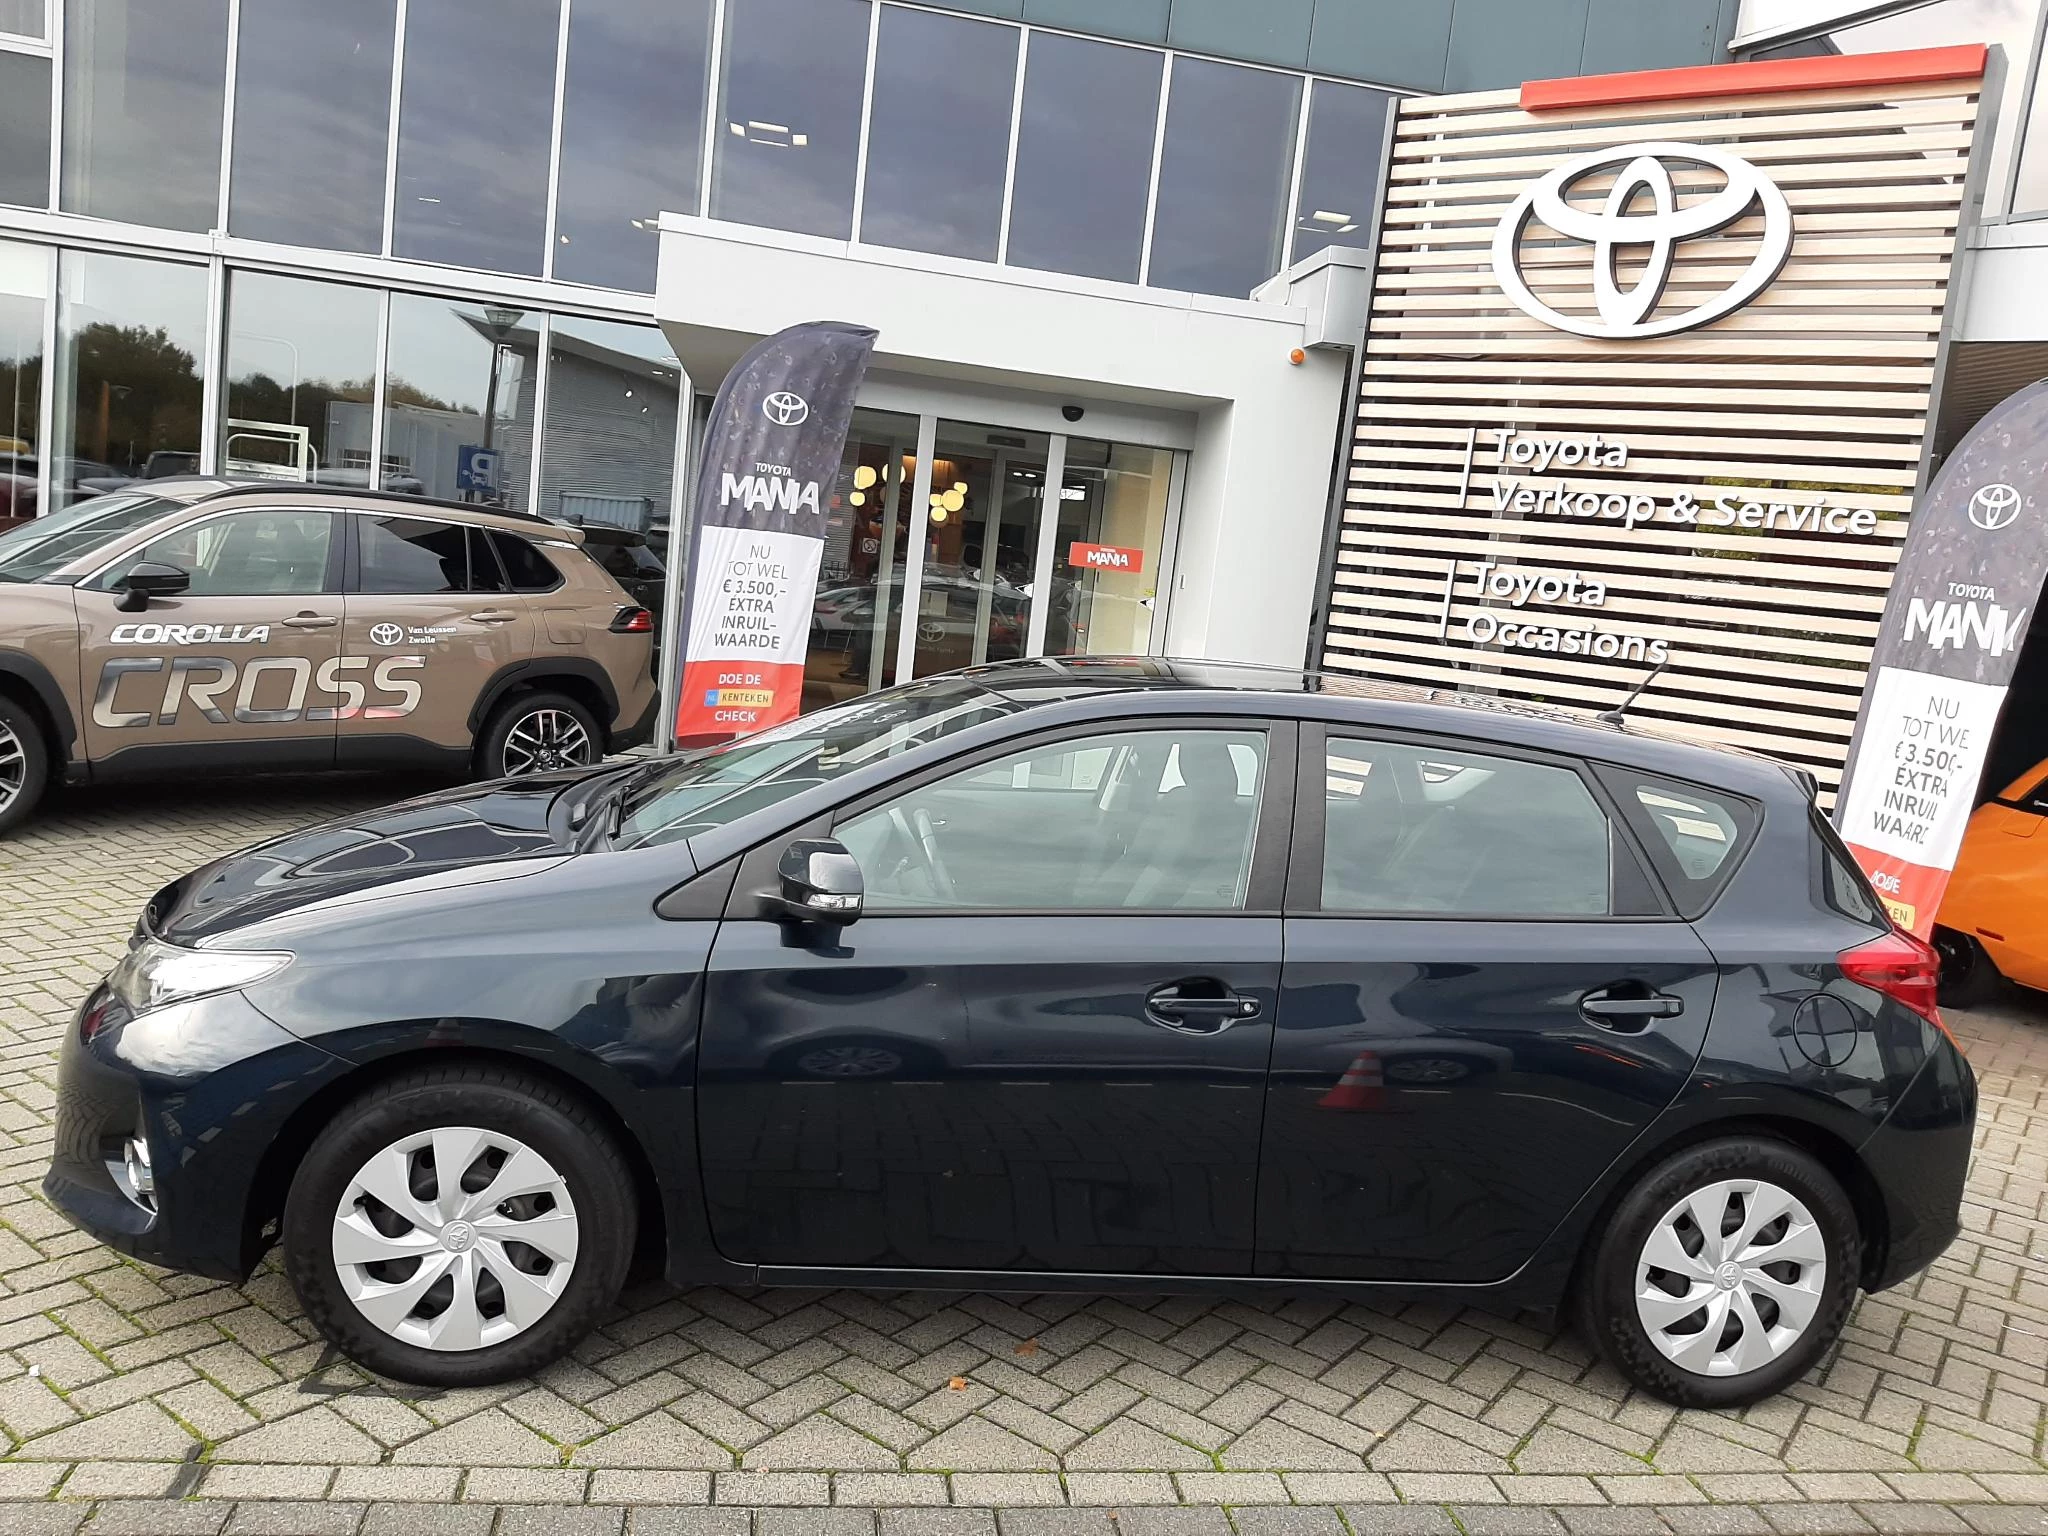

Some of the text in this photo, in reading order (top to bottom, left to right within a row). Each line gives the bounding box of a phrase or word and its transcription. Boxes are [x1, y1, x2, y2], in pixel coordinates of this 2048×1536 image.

[1492, 428, 1630, 473] Toyota
[755, 462, 792, 476] TOYOTA
[721, 472, 820, 515] MANIA
[1491, 478, 1878, 536] Verkoop & Service
[750, 545, 771, 560] NU
[1087, 551, 1129, 567] MANIA
[728, 561, 789, 580] TOT WEL
[723, 579, 786, 598] € 3.500,-
[1472, 561, 1608, 607] Toyota
[1948, 582, 1995, 602] TOYOTA
[408, 626, 423, 634] Van
[721, 615, 777, 631] INRUIL-
[110, 623, 271, 645] COROLLA
[408, 636, 436, 644] Zwolle
[714, 632, 781, 650] WAARDE
[1465, 612, 1669, 665] Occasions
[718, 673, 762, 685] DOE DE
[92, 656, 427, 728] CROSS
[722, 692, 769, 703] KENTEKEN
[714, 710, 757, 722] CHECK
[1927, 696, 1960, 719] NU
[1902, 715, 1934, 740] TOT
